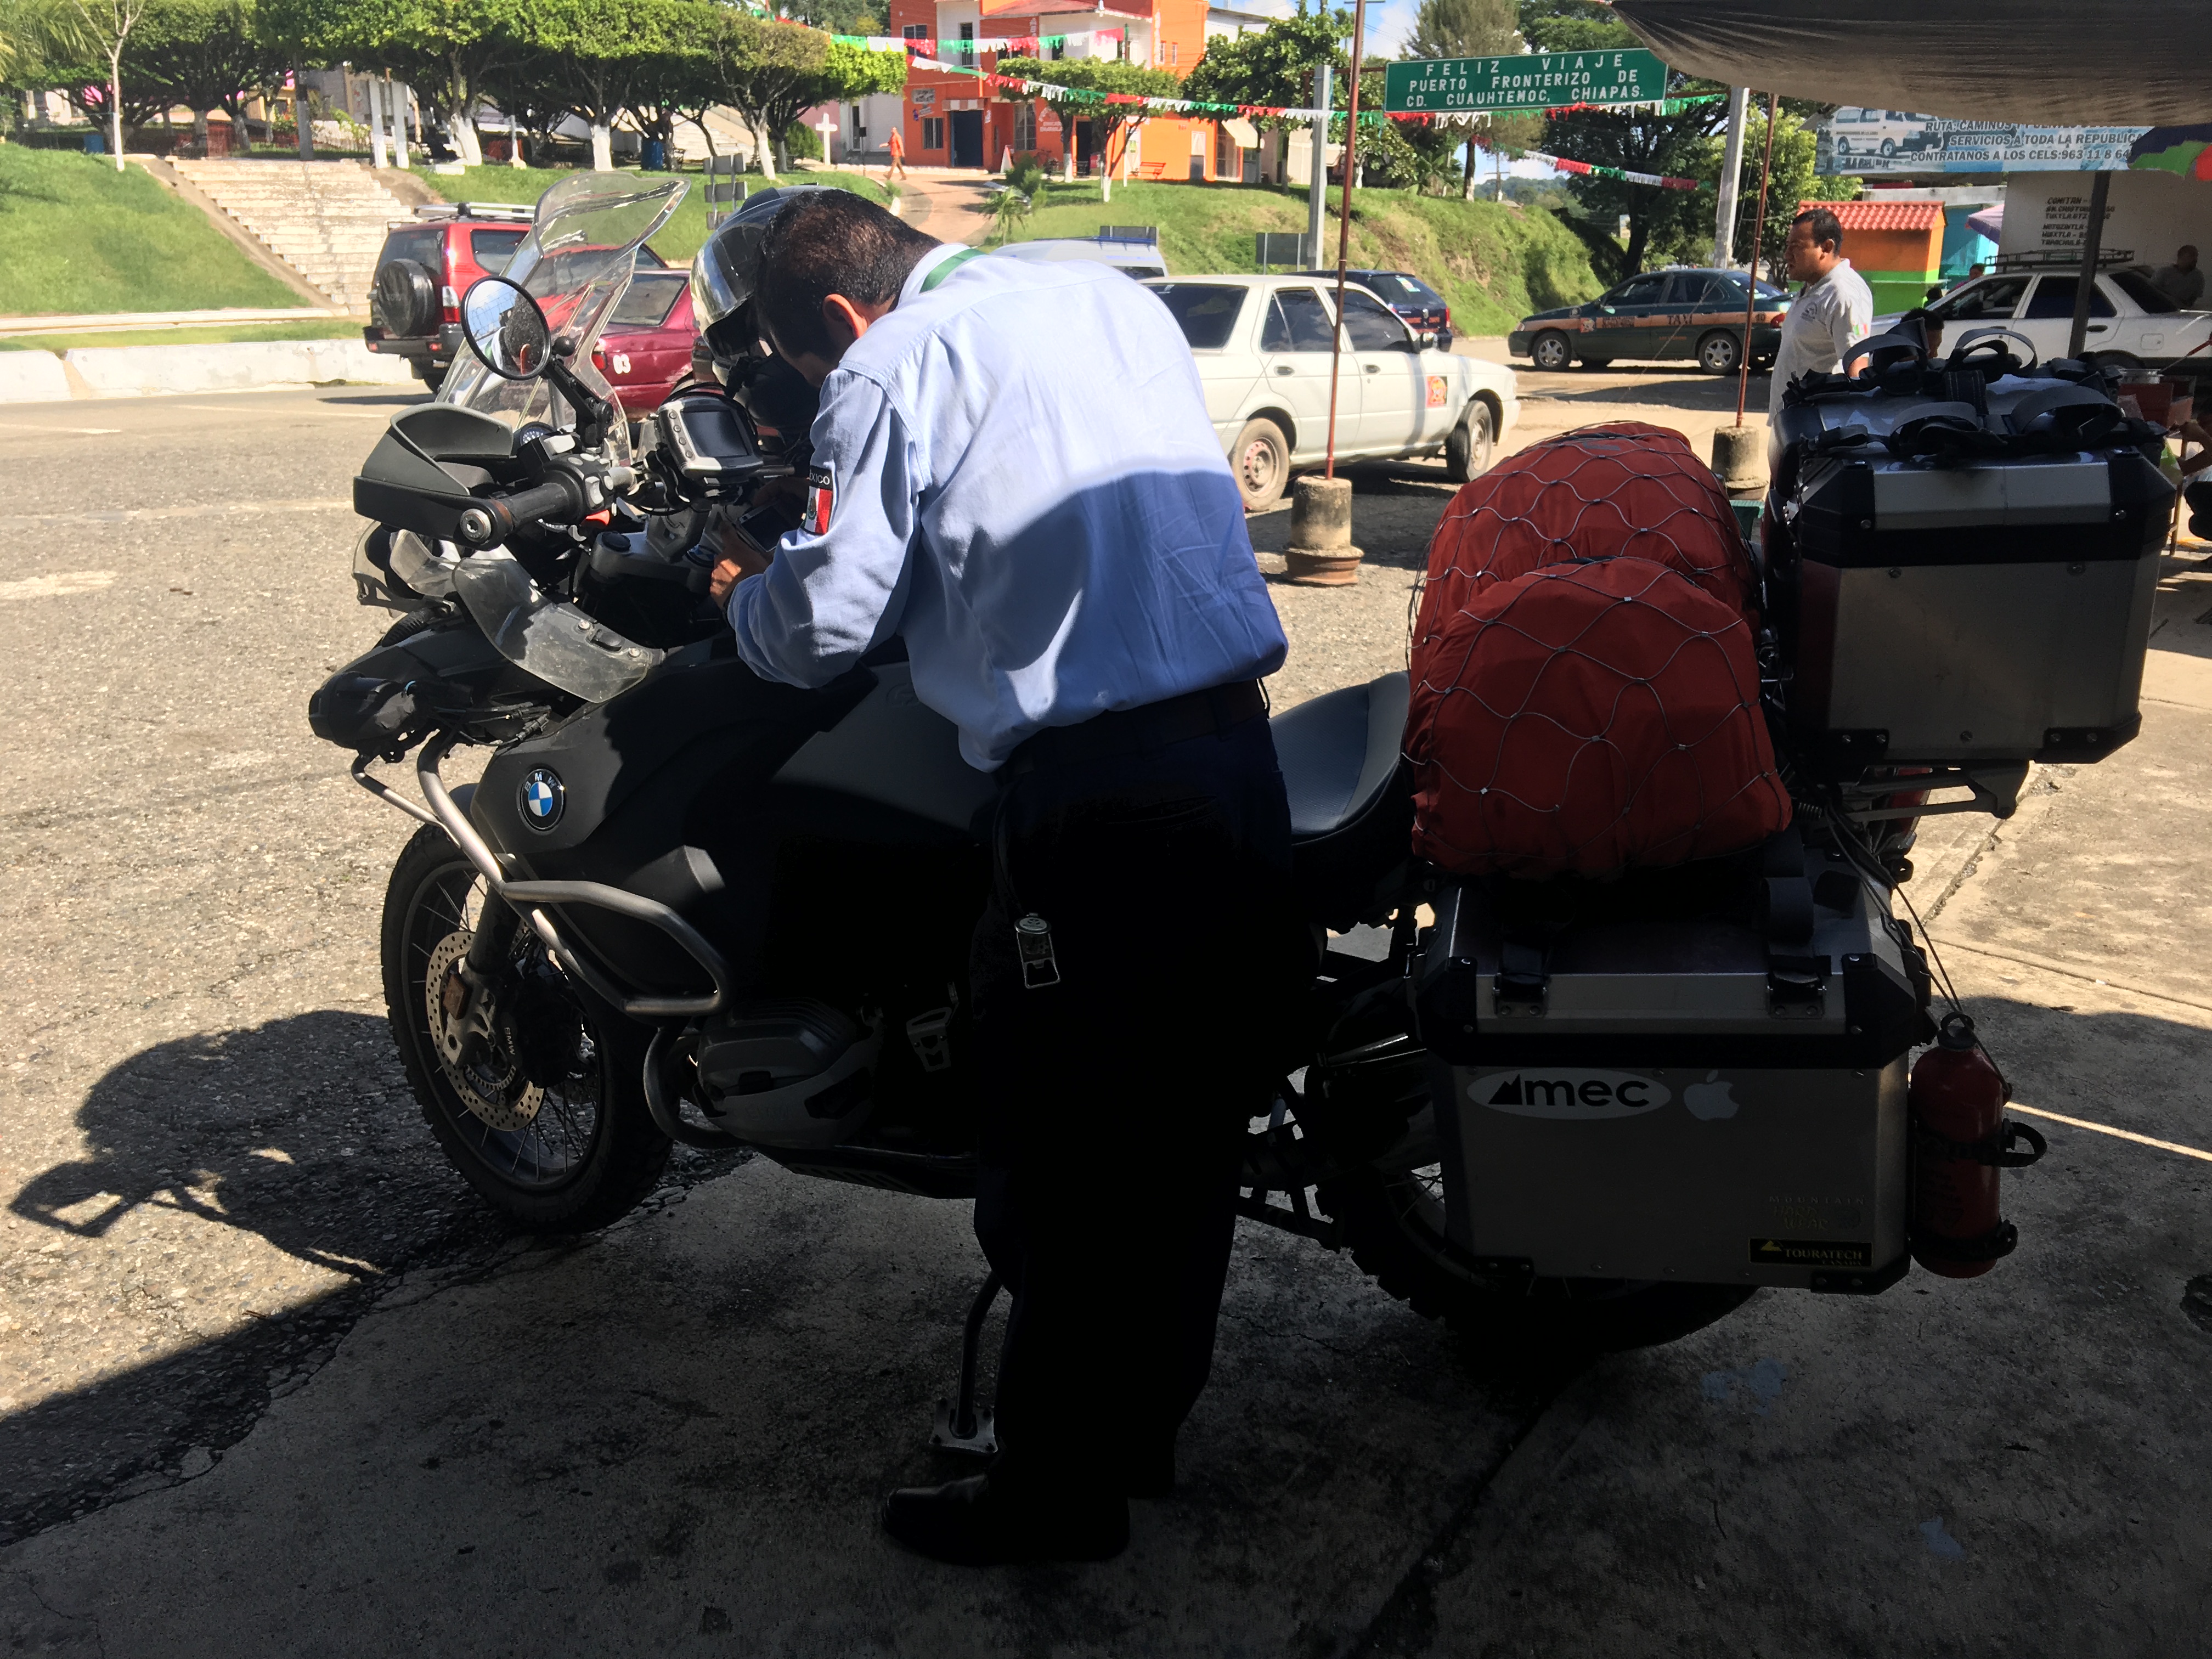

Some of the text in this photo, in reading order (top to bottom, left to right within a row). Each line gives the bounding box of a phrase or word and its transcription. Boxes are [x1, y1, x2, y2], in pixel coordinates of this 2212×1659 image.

[1426, 54, 1623, 77] FELIZ VIAJE
[1409, 69, 1638, 93] PUERTO FRONTERIZO DE
[1406, 94, 1427, 108] CD.
[1571, 85, 1644, 101] CHIAPAS.
[1950, 134, 2011, 146] SERVICIOS
[2014, 135, 2021, 145] A
[2025, 134, 2054, 144] TODA
[2058, 134, 2072, 144] LA
[1911, 150, 1990, 162] CONTRATANOS
[1993, 151, 2000, 160] A
[2004, 150, 2025, 160] LOS
[2087, 149, 2101, 159] 11
[613, 354, 631, 374] 03
[524, 772, 557, 792] BMW
[504, 1027, 516, 1055] BMW
[1525, 1080, 1650, 1108] mec
[1785, 1248, 1863, 1261] TOURATECH
